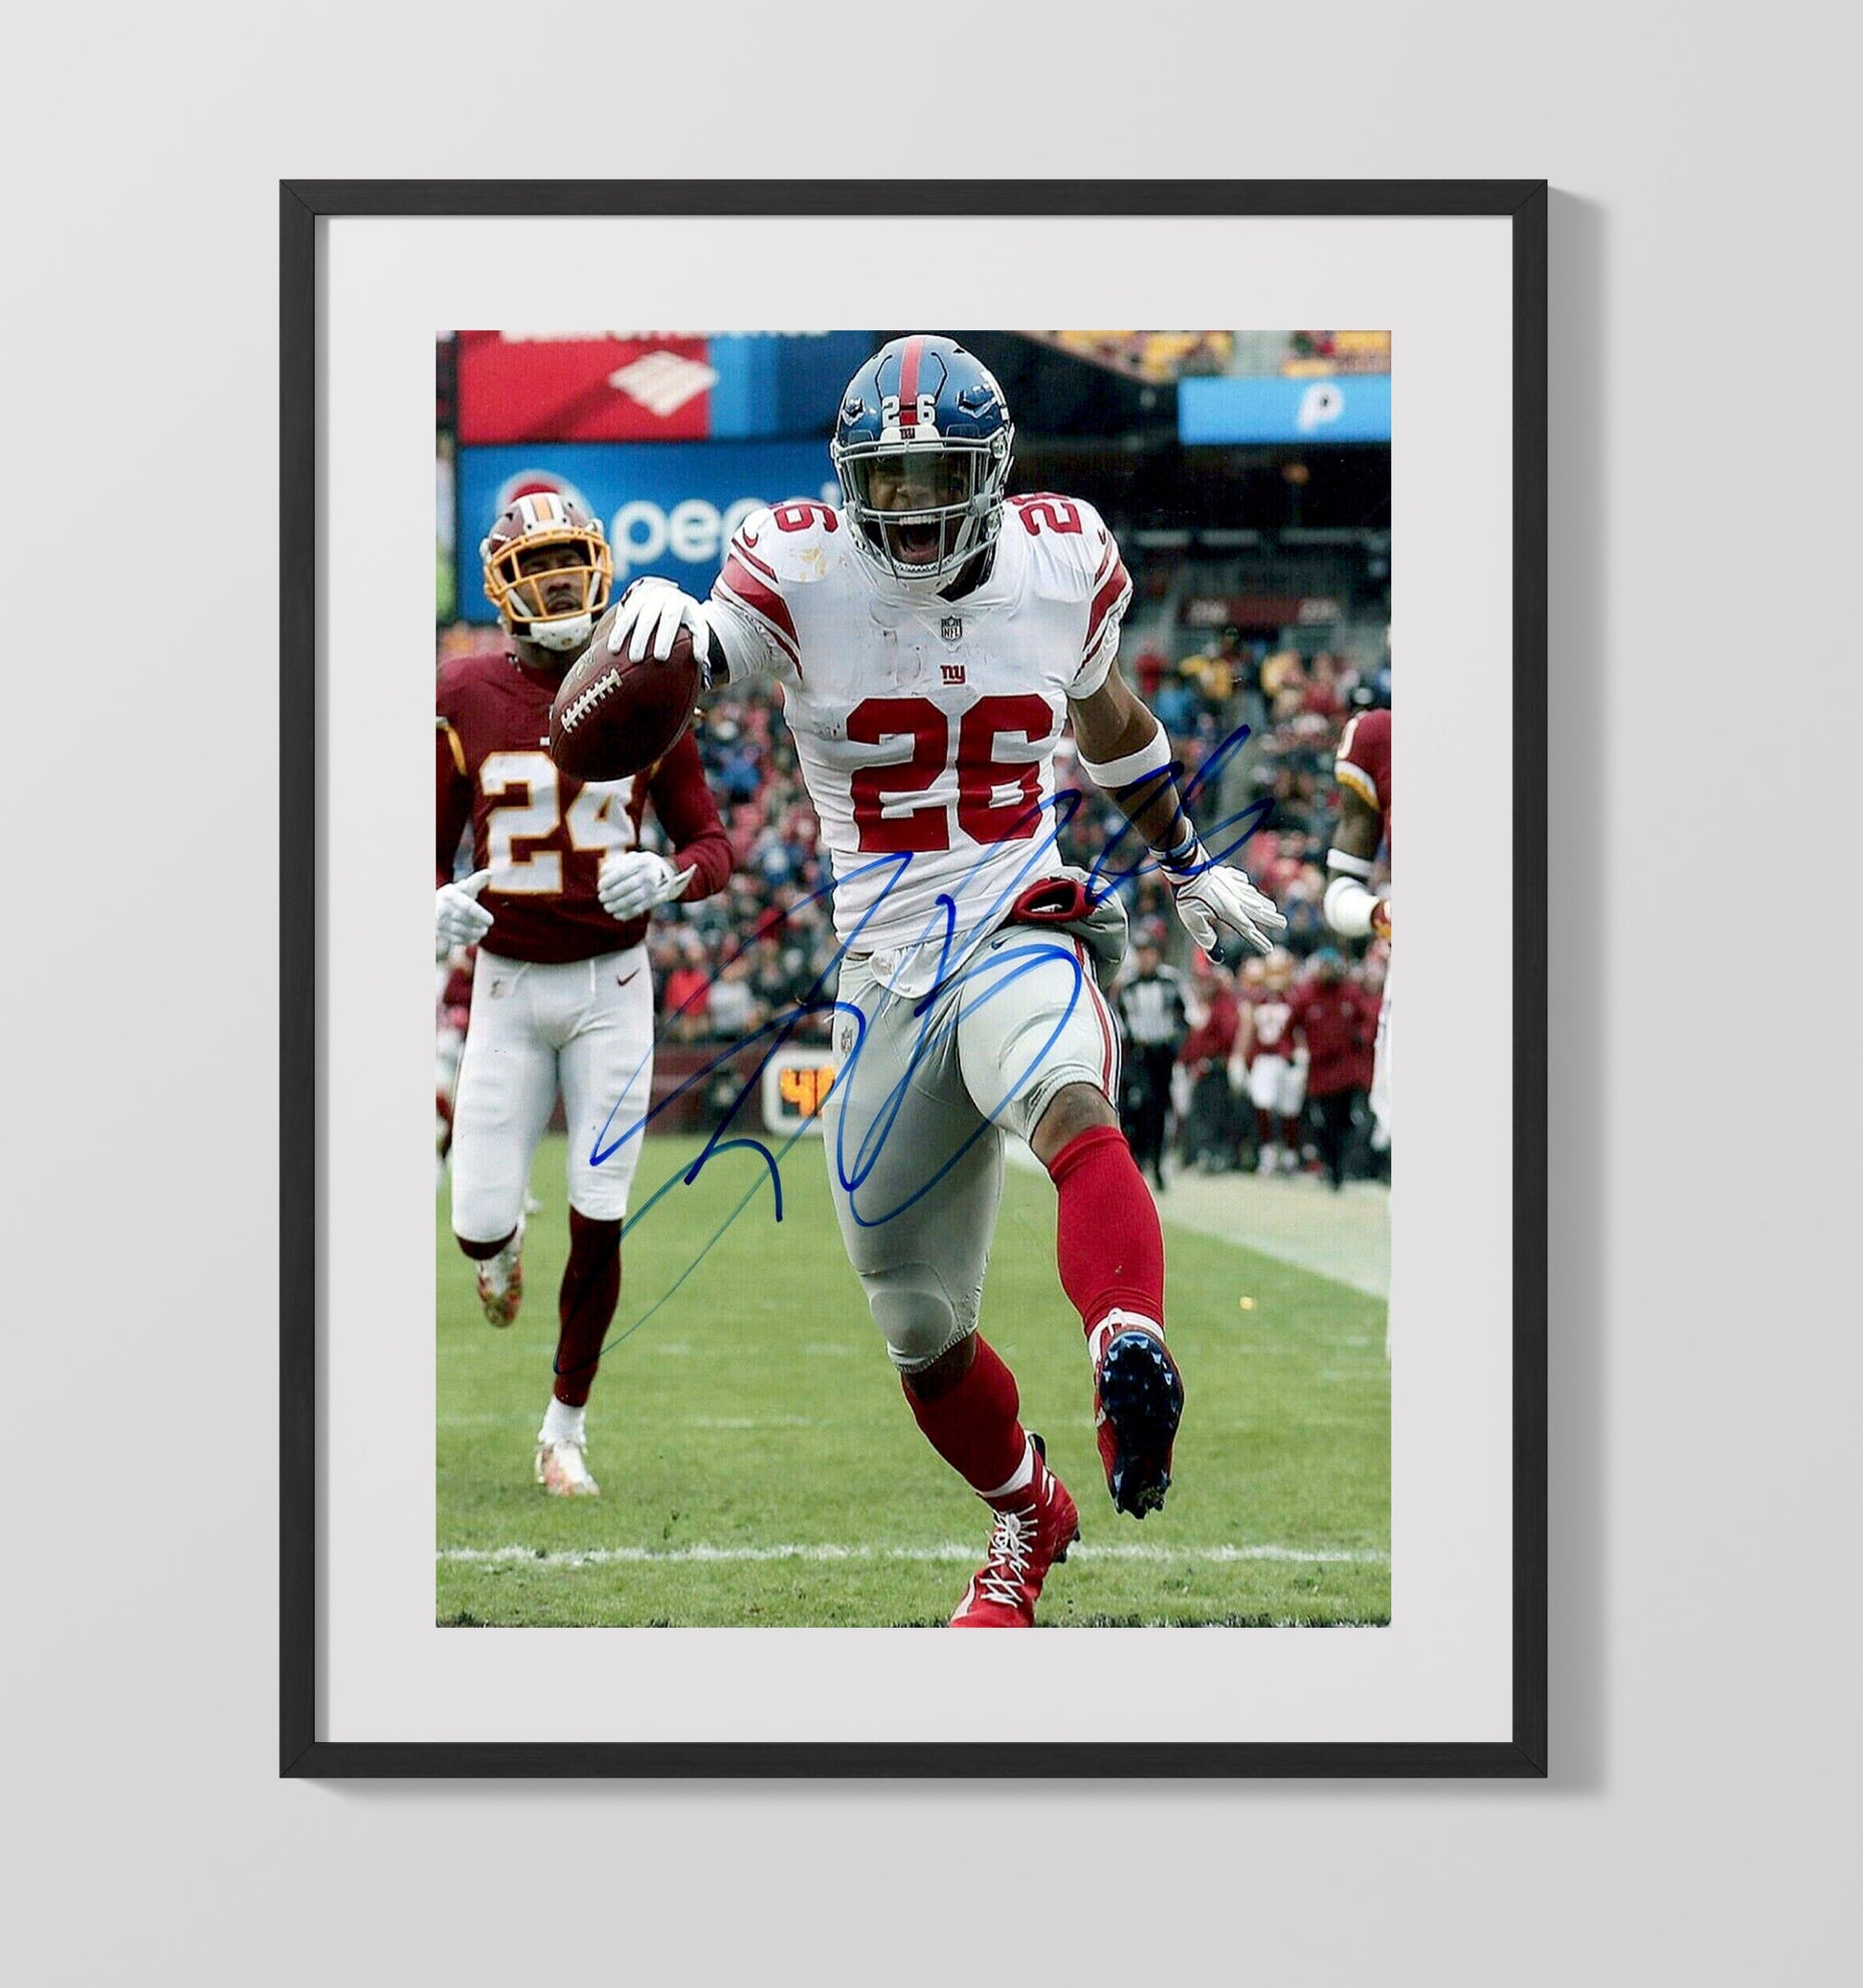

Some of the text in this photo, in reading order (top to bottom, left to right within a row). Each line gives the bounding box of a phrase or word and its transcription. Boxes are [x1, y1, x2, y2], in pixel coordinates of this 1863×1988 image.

[882, 394, 935, 427] 26
[479, 750, 637, 894] 24
[846, 693, 1054, 853] 26
